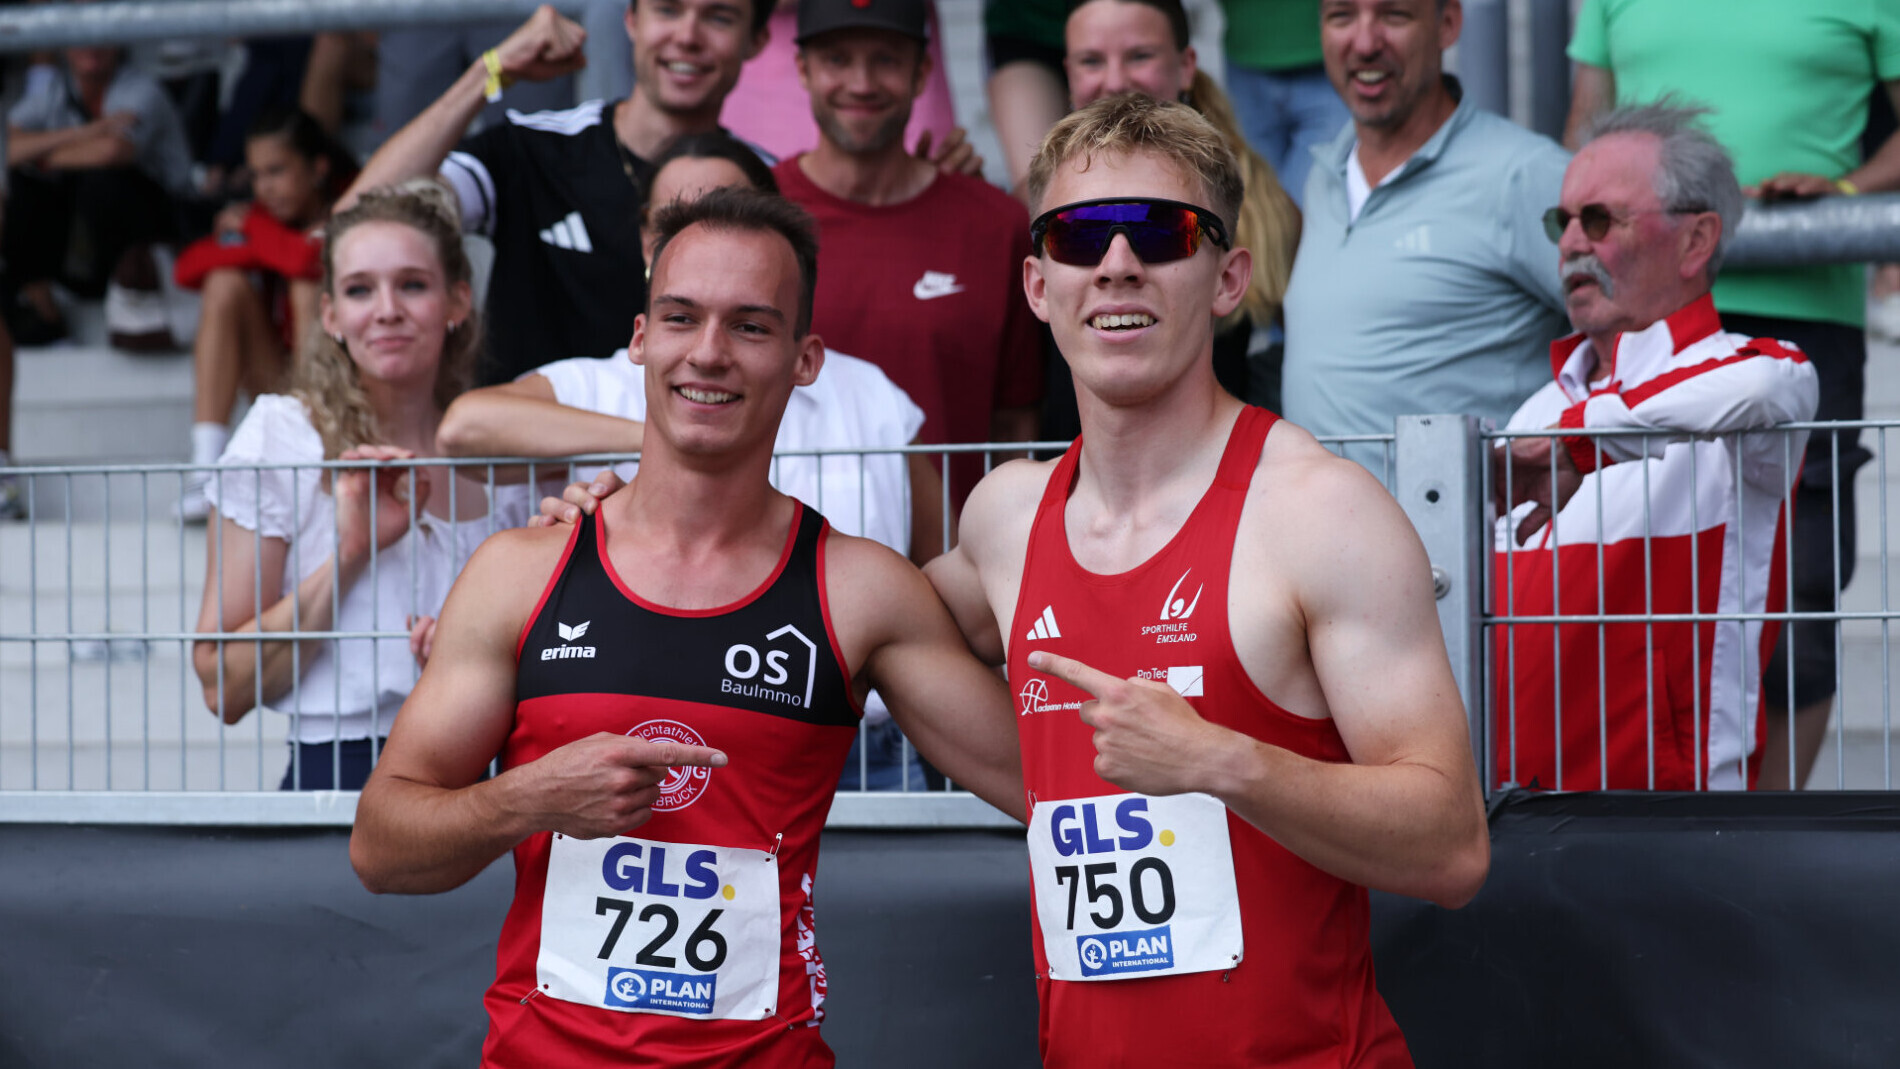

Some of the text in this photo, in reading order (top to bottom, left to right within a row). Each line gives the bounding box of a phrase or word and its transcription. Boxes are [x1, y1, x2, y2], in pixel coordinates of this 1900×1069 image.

[1141, 622, 1188, 635] SPORTHILFE
[1156, 633, 1197, 644] EMSLAND
[540, 644, 596, 661] erima
[724, 644, 790, 686] OS
[652, 783, 697, 807] BRÜCK
[1054, 856, 1176, 931] 750
[595, 896, 727, 972] 726
[1109, 935, 1168, 959] PLAN
[1112, 957, 1169, 968] INTERNATIONAL
[650, 978, 711, 1000] PLAN
[650, 998, 710, 1010] INTERNATIONAL
